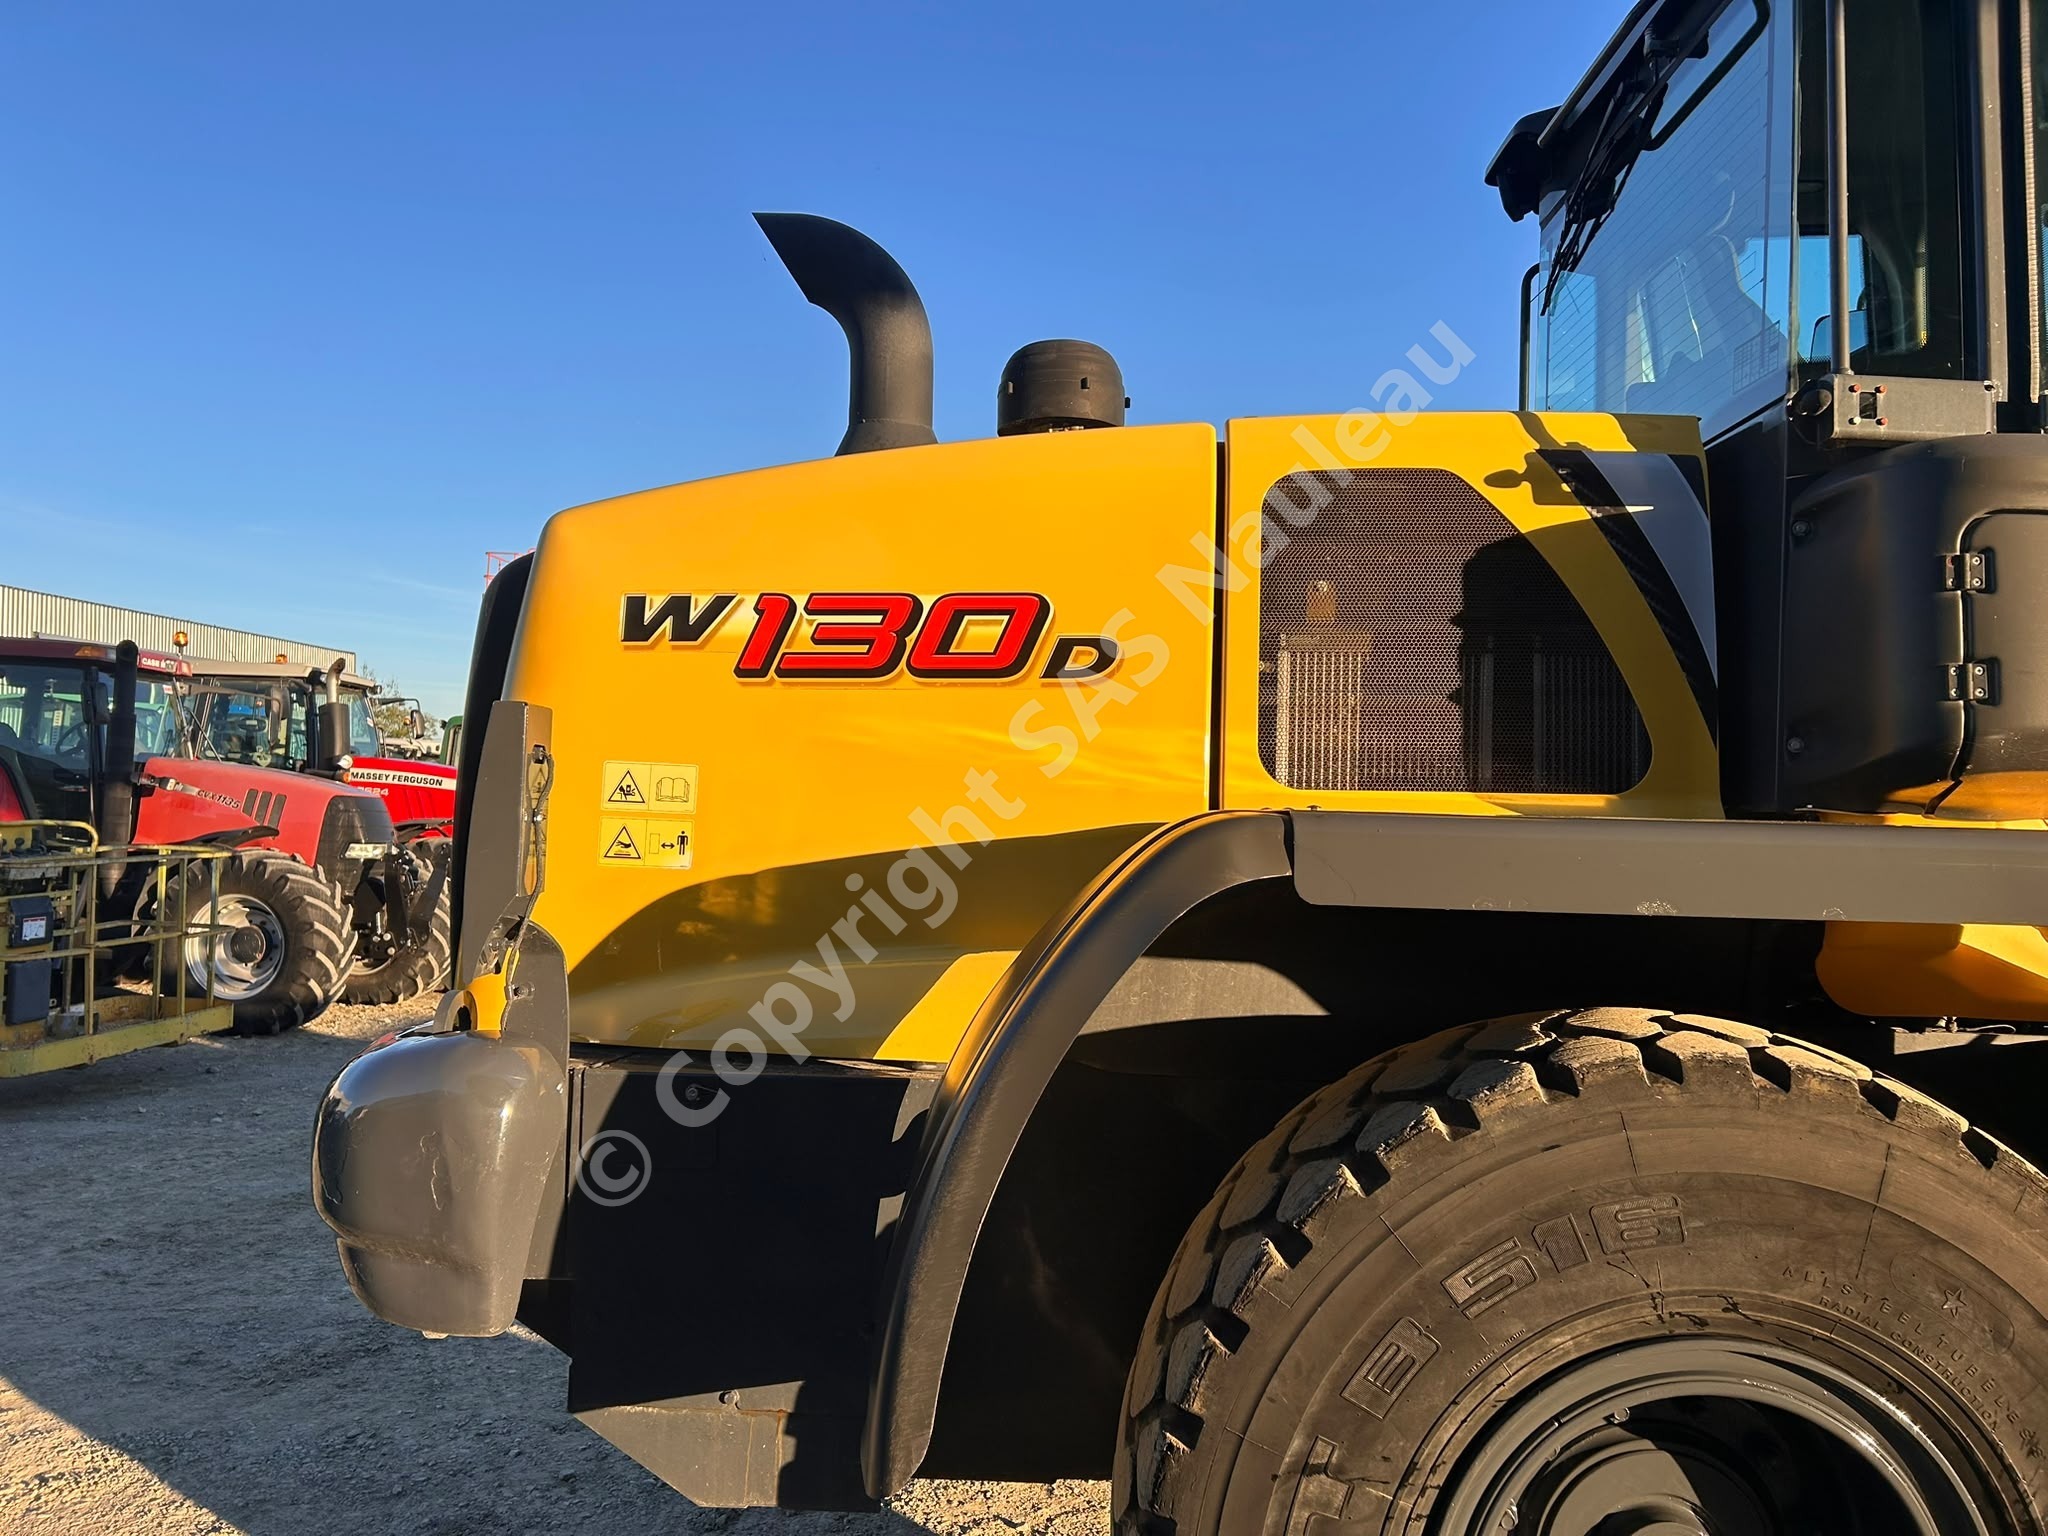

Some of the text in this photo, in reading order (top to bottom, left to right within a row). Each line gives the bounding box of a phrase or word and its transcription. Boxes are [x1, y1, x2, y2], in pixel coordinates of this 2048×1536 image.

[351, 771, 443, 786] MASSEY FERGUSON
[1818, 1296, 2000, 1434] RADIAL CONSTRUCTION
